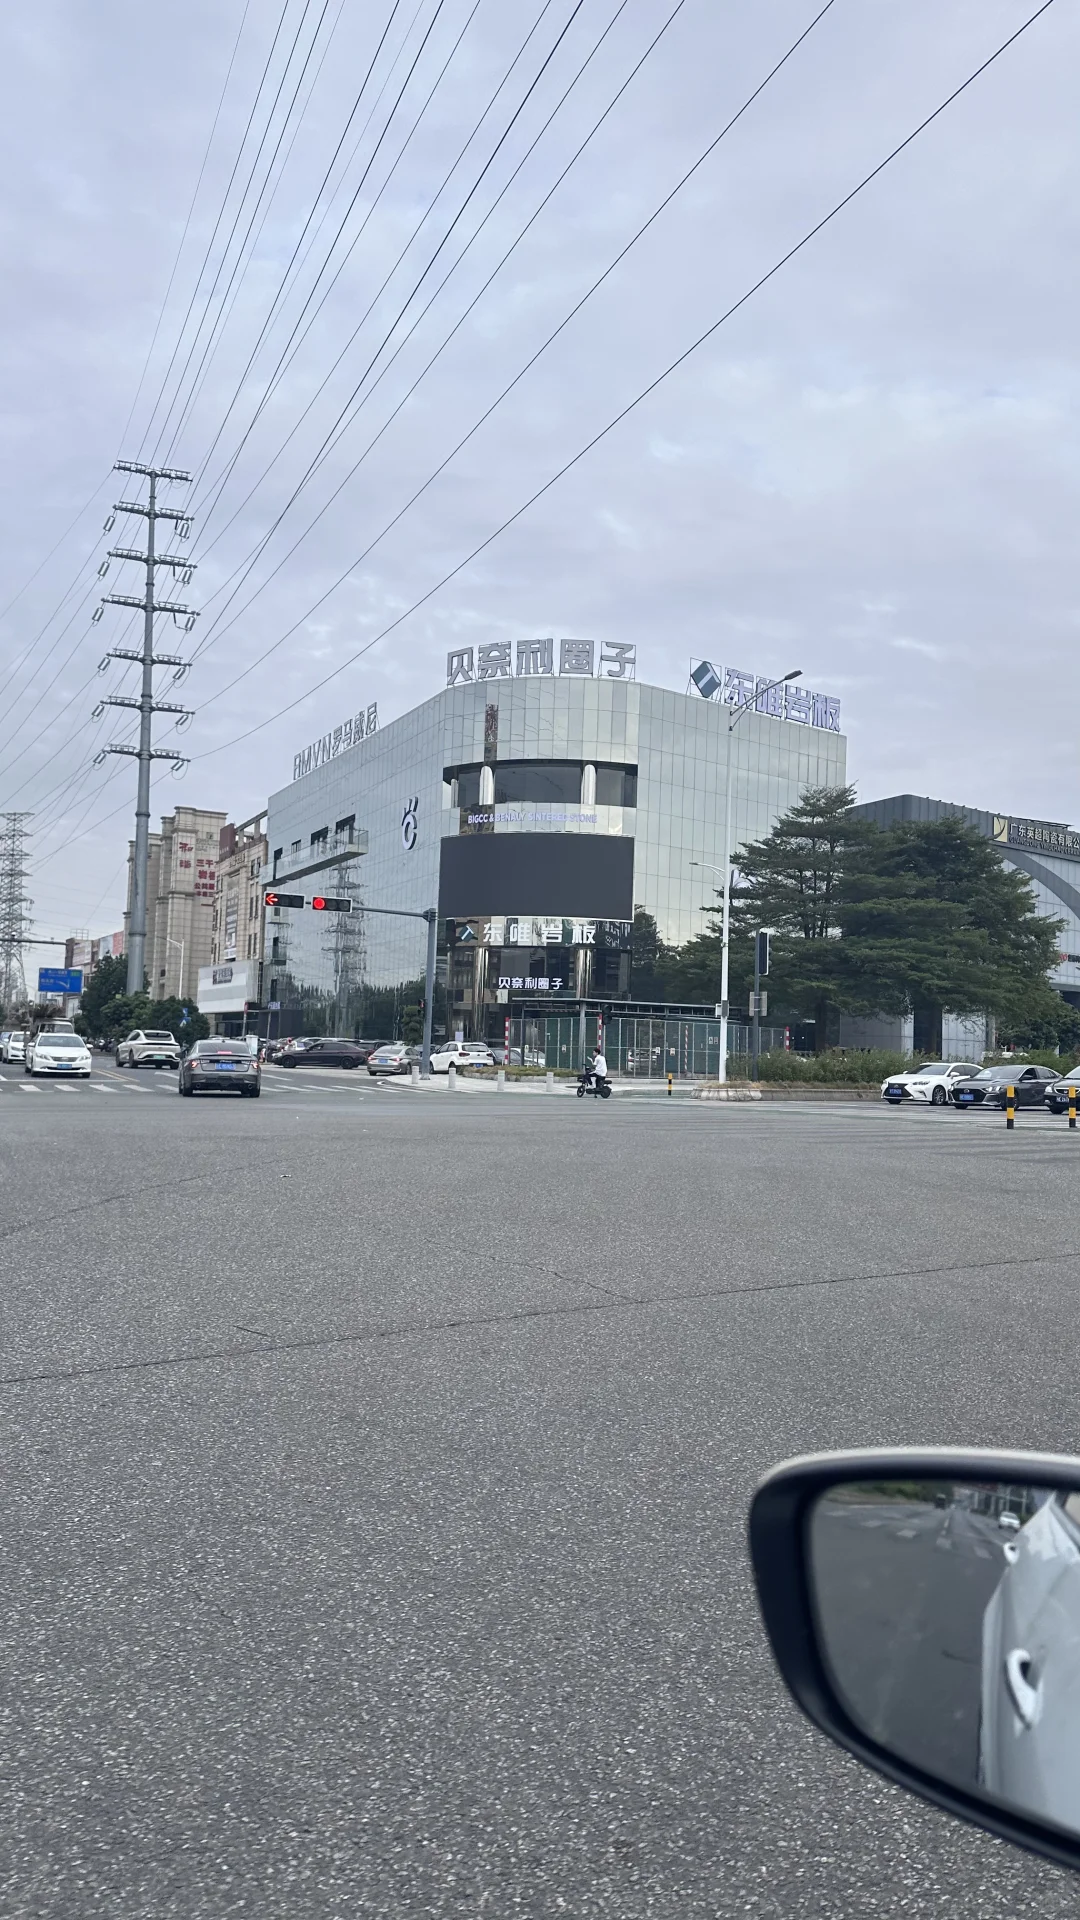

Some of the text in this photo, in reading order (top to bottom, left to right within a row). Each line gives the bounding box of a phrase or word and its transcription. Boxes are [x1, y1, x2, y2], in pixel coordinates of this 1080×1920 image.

[446, 638, 636, 684] 贝奈利圈子
[725, 668, 841, 732] 东唯岩板
[467, 814, 489, 824] BIGCC
[569, 813, 598, 824] STONE
[483, 922, 597, 944] 东唯岩板
[498, 976, 564, 990] 贝奈利圈子
